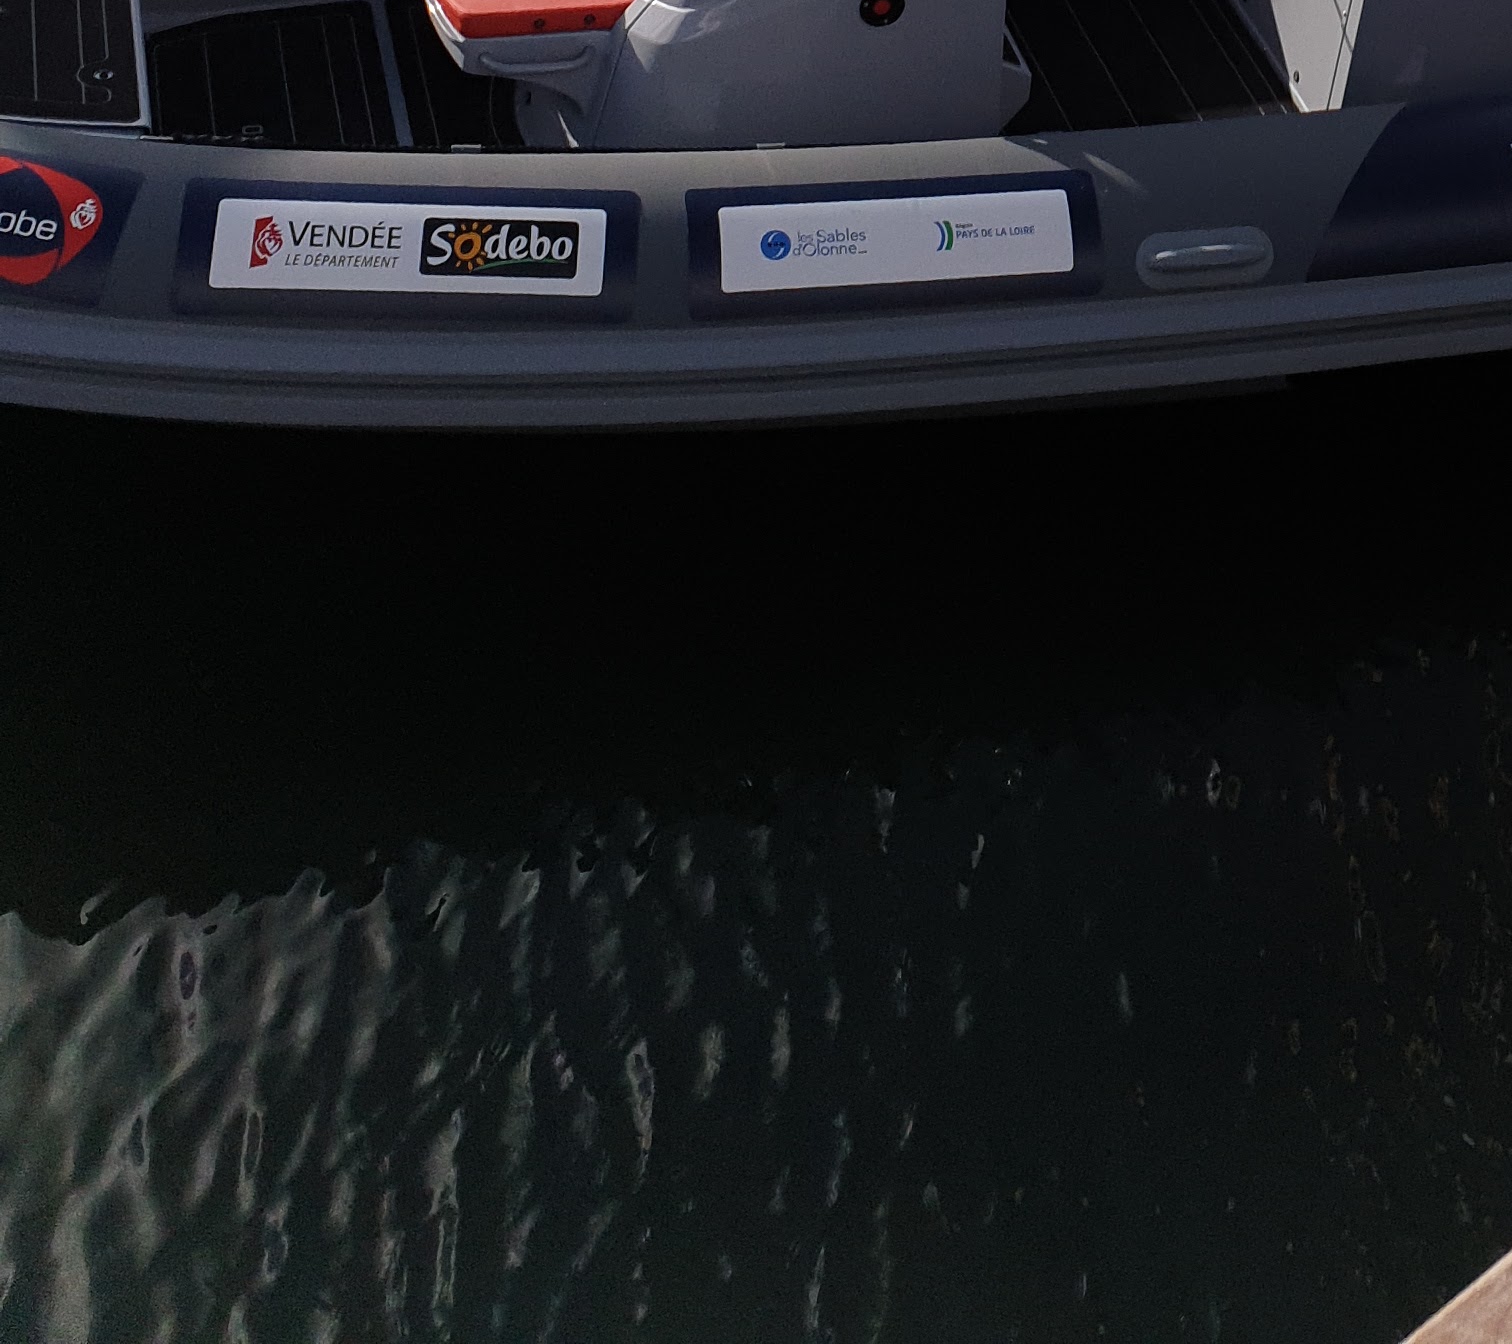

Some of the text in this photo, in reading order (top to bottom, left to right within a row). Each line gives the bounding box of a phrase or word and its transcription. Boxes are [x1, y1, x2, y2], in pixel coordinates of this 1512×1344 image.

[288, 220, 403, 250] VENDÉE
[816, 228, 867, 243] Sables
[956, 225, 1035, 239] PAYS DE LA LOIRE
[424, 221, 575, 268] Sodebo
[284, 252, 400, 269] LE DÉPARTEMENT
